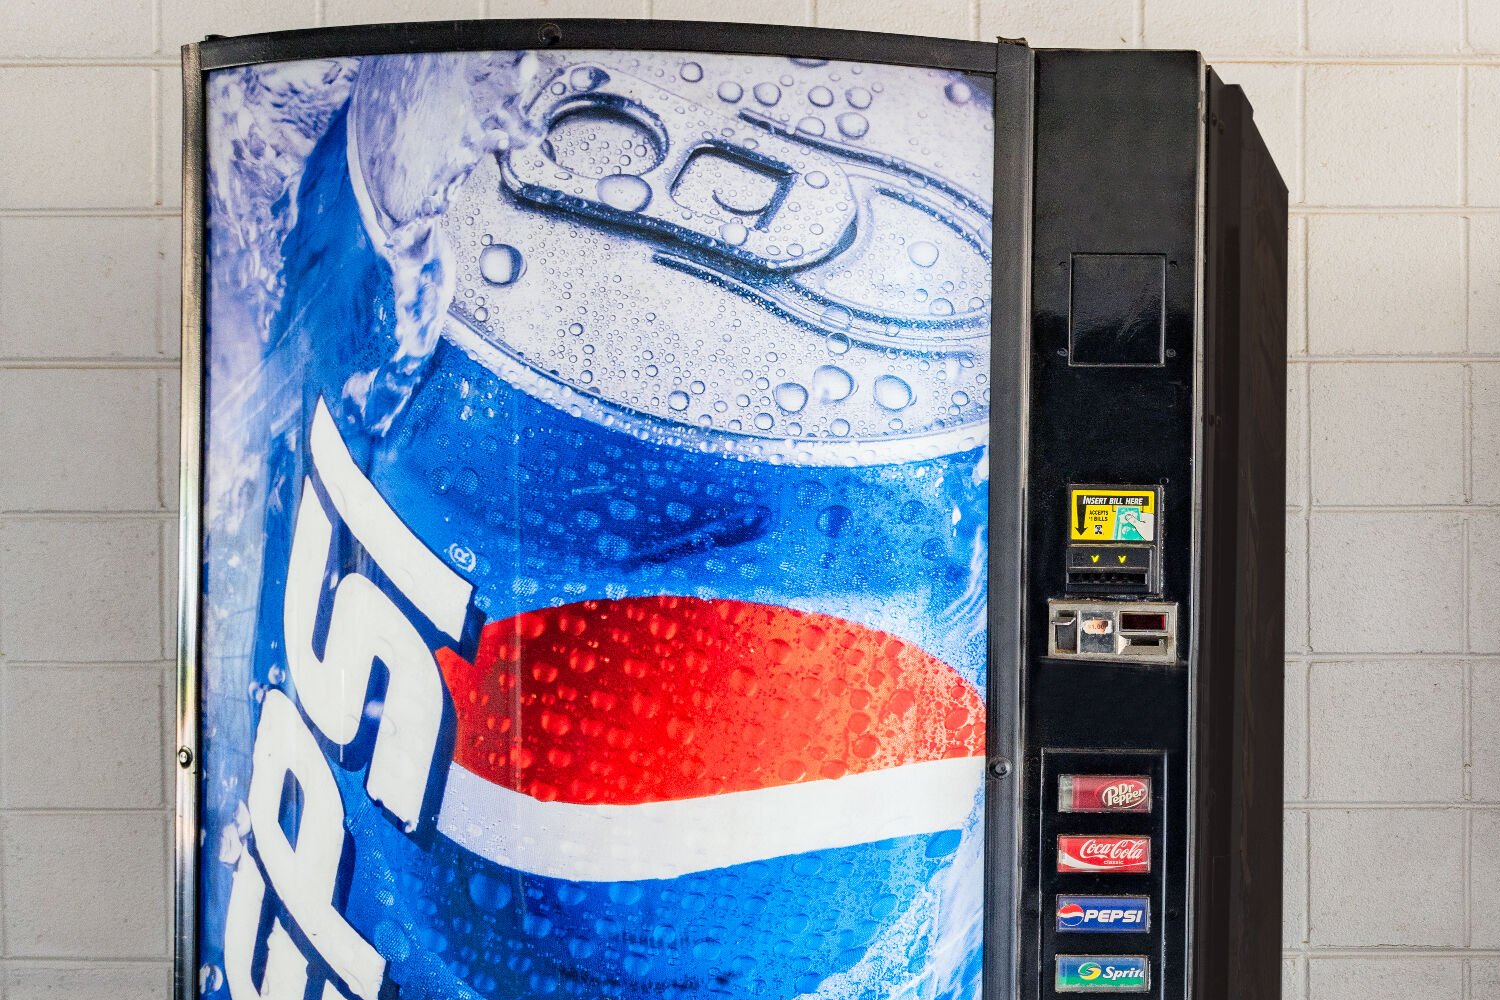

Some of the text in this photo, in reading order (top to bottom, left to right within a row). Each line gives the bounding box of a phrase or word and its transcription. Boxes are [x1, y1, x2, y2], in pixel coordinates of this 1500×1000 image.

[1083, 496, 1108, 504] INSERT
[1107, 786, 1144, 806] Pepper
[1118, 784, 1135, 796] Dr
[1080, 840, 1146, 859] Coca-Cola
[1084, 910, 1142, 922] PEPSI
